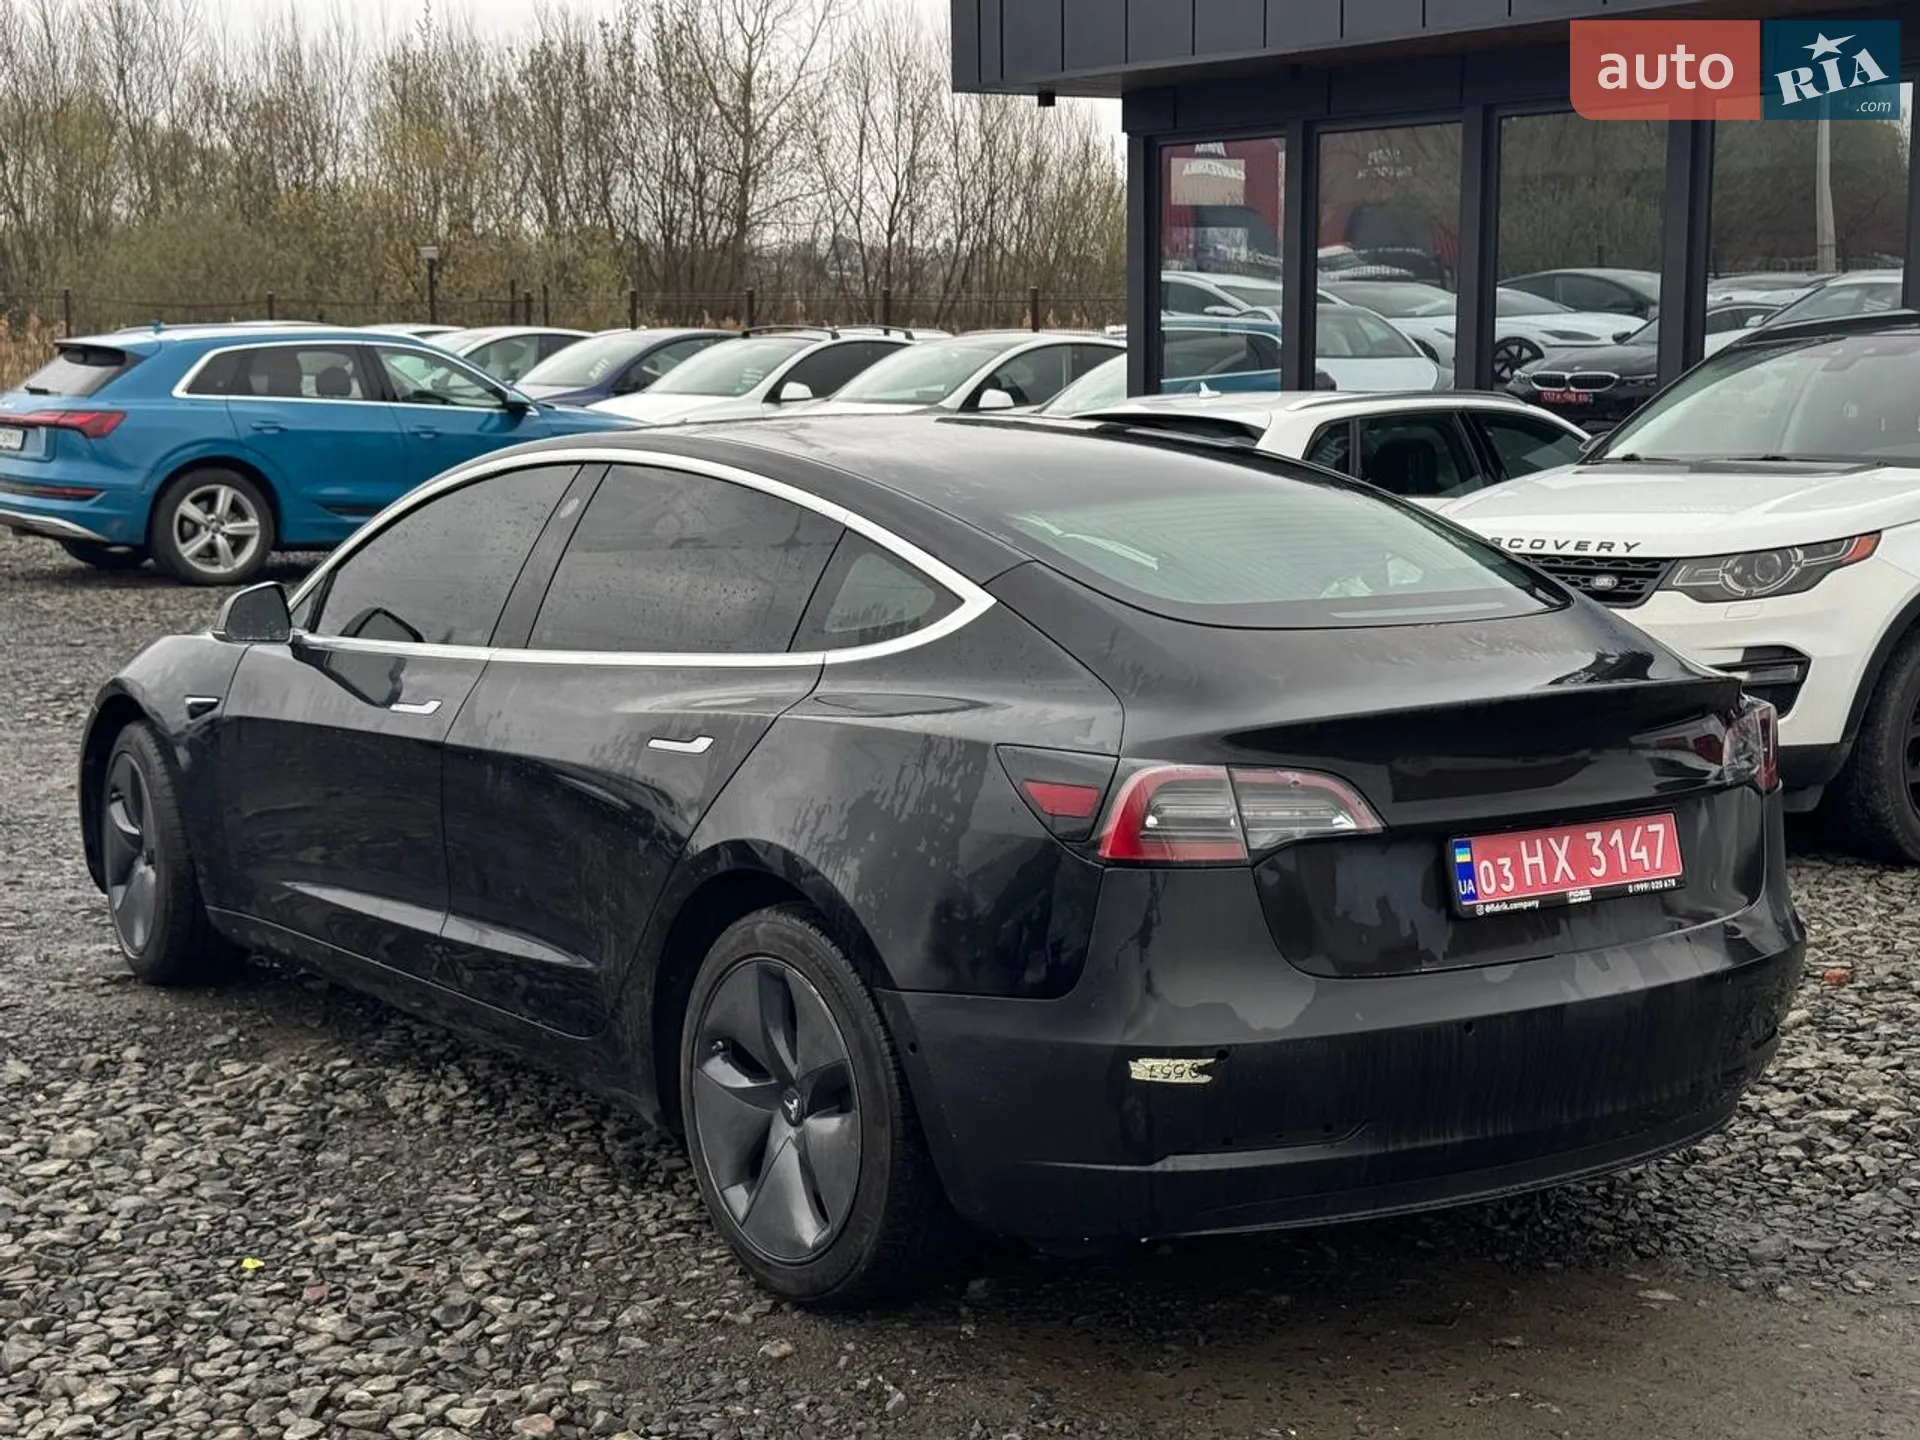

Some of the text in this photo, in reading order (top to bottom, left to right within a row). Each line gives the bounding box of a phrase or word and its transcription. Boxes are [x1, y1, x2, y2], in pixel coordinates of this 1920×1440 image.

[1478, 824, 1665, 895] 03 HX 3147
[1458, 879, 1476, 895] UA
